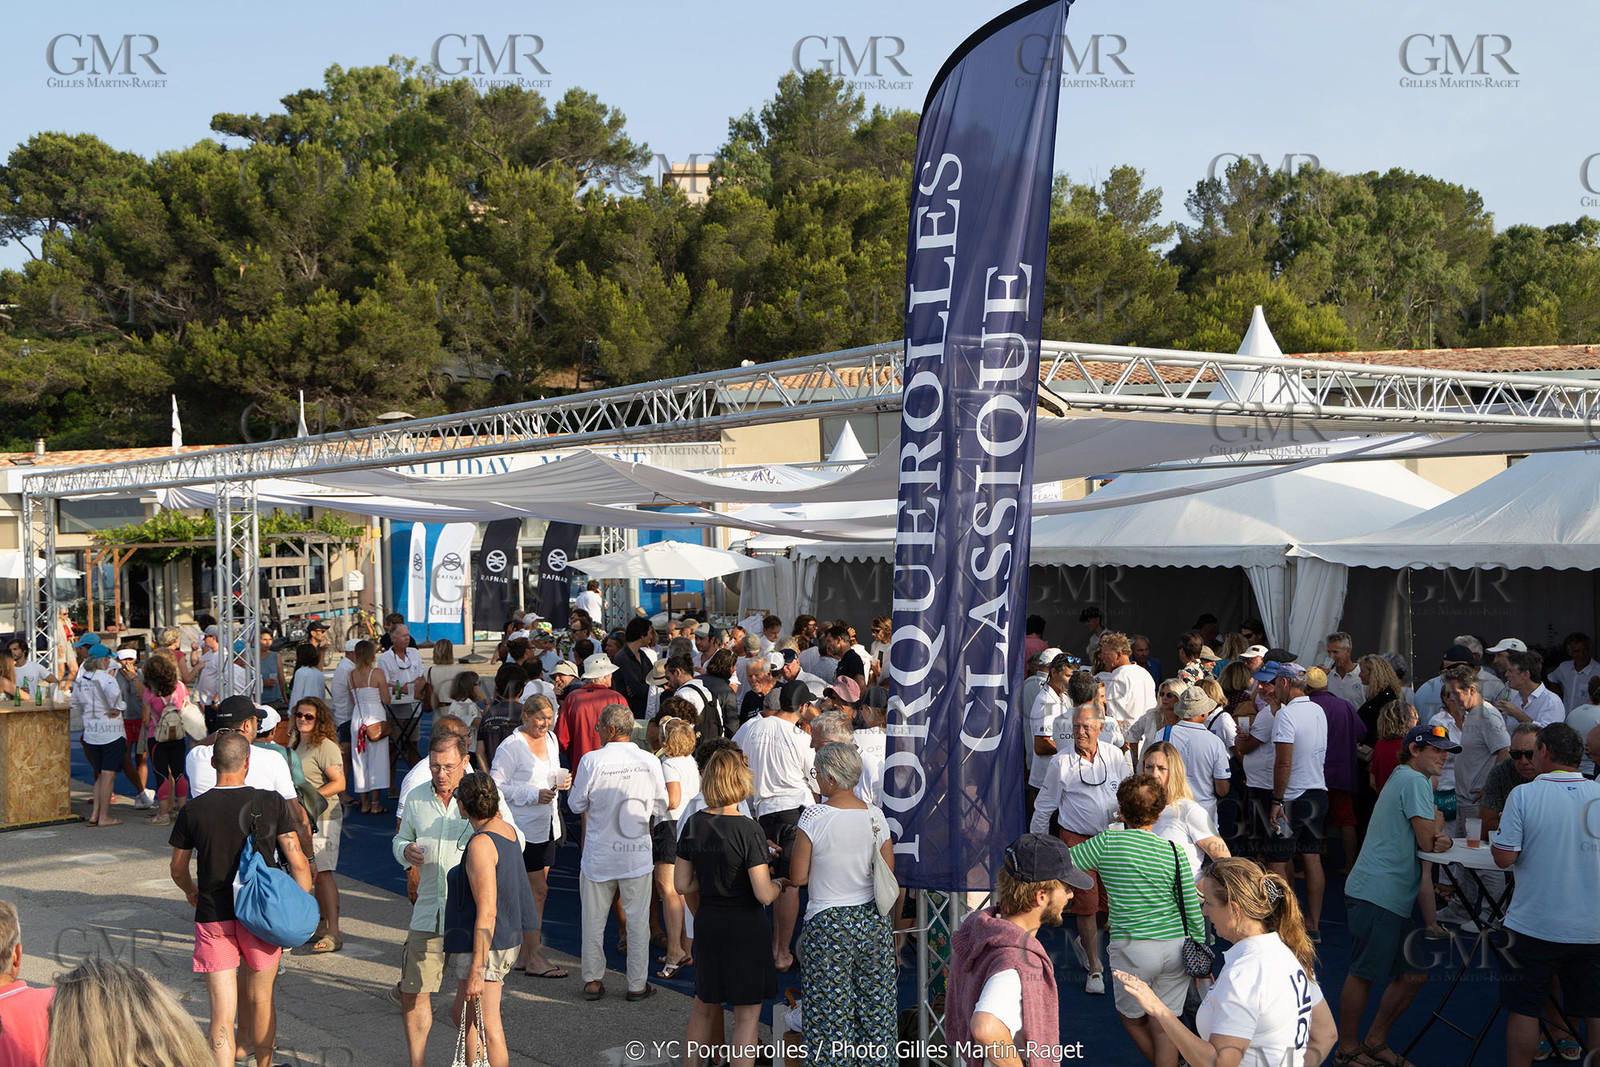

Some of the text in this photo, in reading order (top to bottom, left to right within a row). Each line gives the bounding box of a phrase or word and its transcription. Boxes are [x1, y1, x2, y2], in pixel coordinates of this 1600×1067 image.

[395, 457, 514, 475] ALLIDAY
[883, 152, 964, 862] PORQUEROLLES
[960, 262, 1033, 752] CLASSIQUE
[480, 574, 508, 584] RAFNAR
[542, 573, 568, 583] RAFNAR
